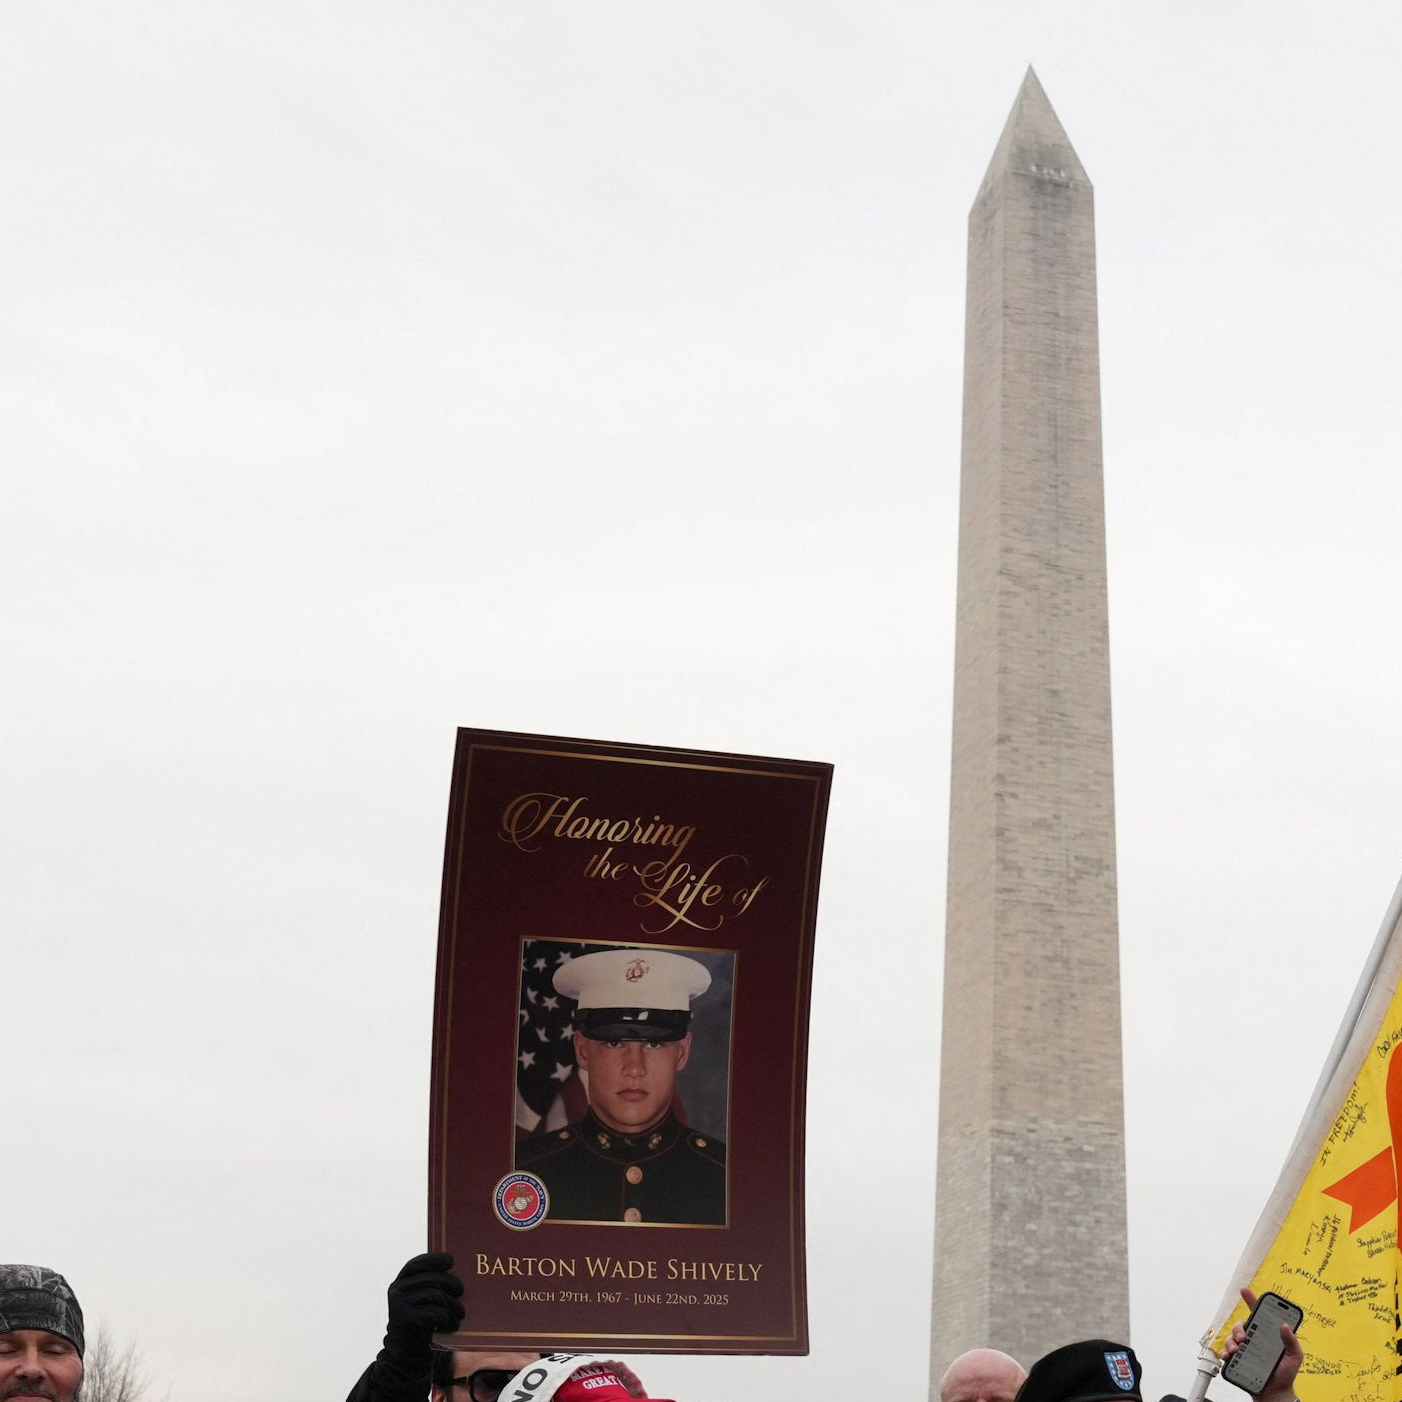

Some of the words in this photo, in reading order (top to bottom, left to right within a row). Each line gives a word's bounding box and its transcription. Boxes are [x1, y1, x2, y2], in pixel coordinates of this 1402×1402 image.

[498, 792, 696, 884] Honoring
[583, 847, 629, 880] the
[632, 854, 748, 934] Life
[730, 874, 773, 919] of
[476, 1254, 576, 1278] BARTON
[585, 1257, 658, 1280] WADE
[667, 1258, 763, 1283] SHIVELY
[596, 1292, 622, 1303] 1967
[703, 1295, 729, 1306] 2025
[570, 1366, 602, 1382] MAKE
[582, 1375, 618, 1390] GREAT
